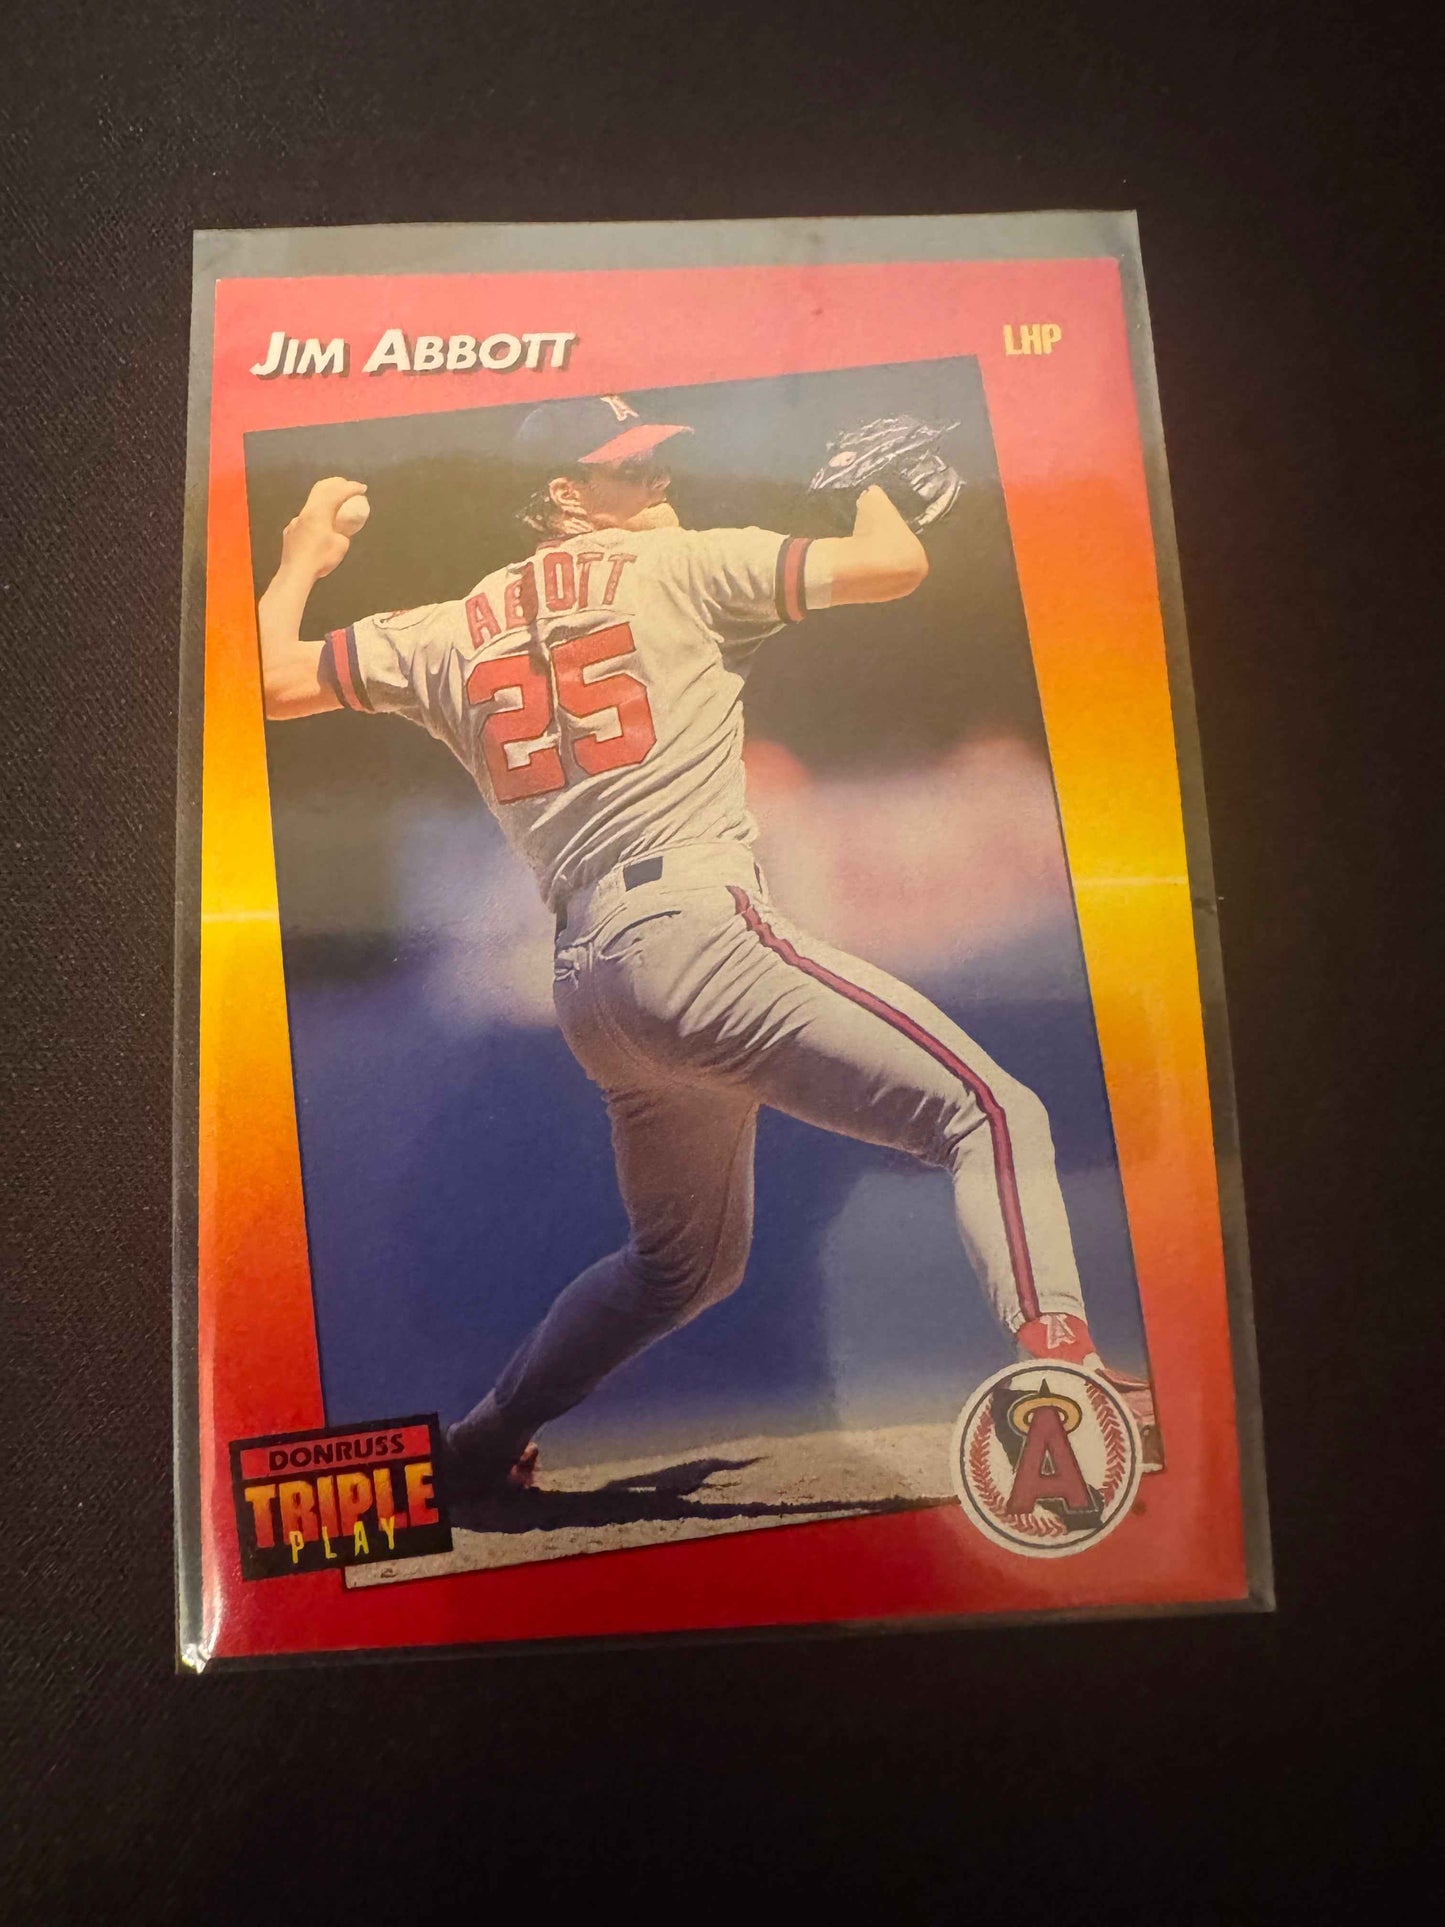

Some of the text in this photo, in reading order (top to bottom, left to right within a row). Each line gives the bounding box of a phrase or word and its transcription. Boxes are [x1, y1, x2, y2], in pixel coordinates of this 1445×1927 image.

[249, 328, 578, 378] JIM ABBOTT
[1003, 323, 1062, 356] LHP
[466, 621, 658, 805] 25
[268, 1432, 405, 1471] DONRUSS
[244, 1462, 439, 1549] TRIPLE
[289, 1515, 396, 1564] PLAY
